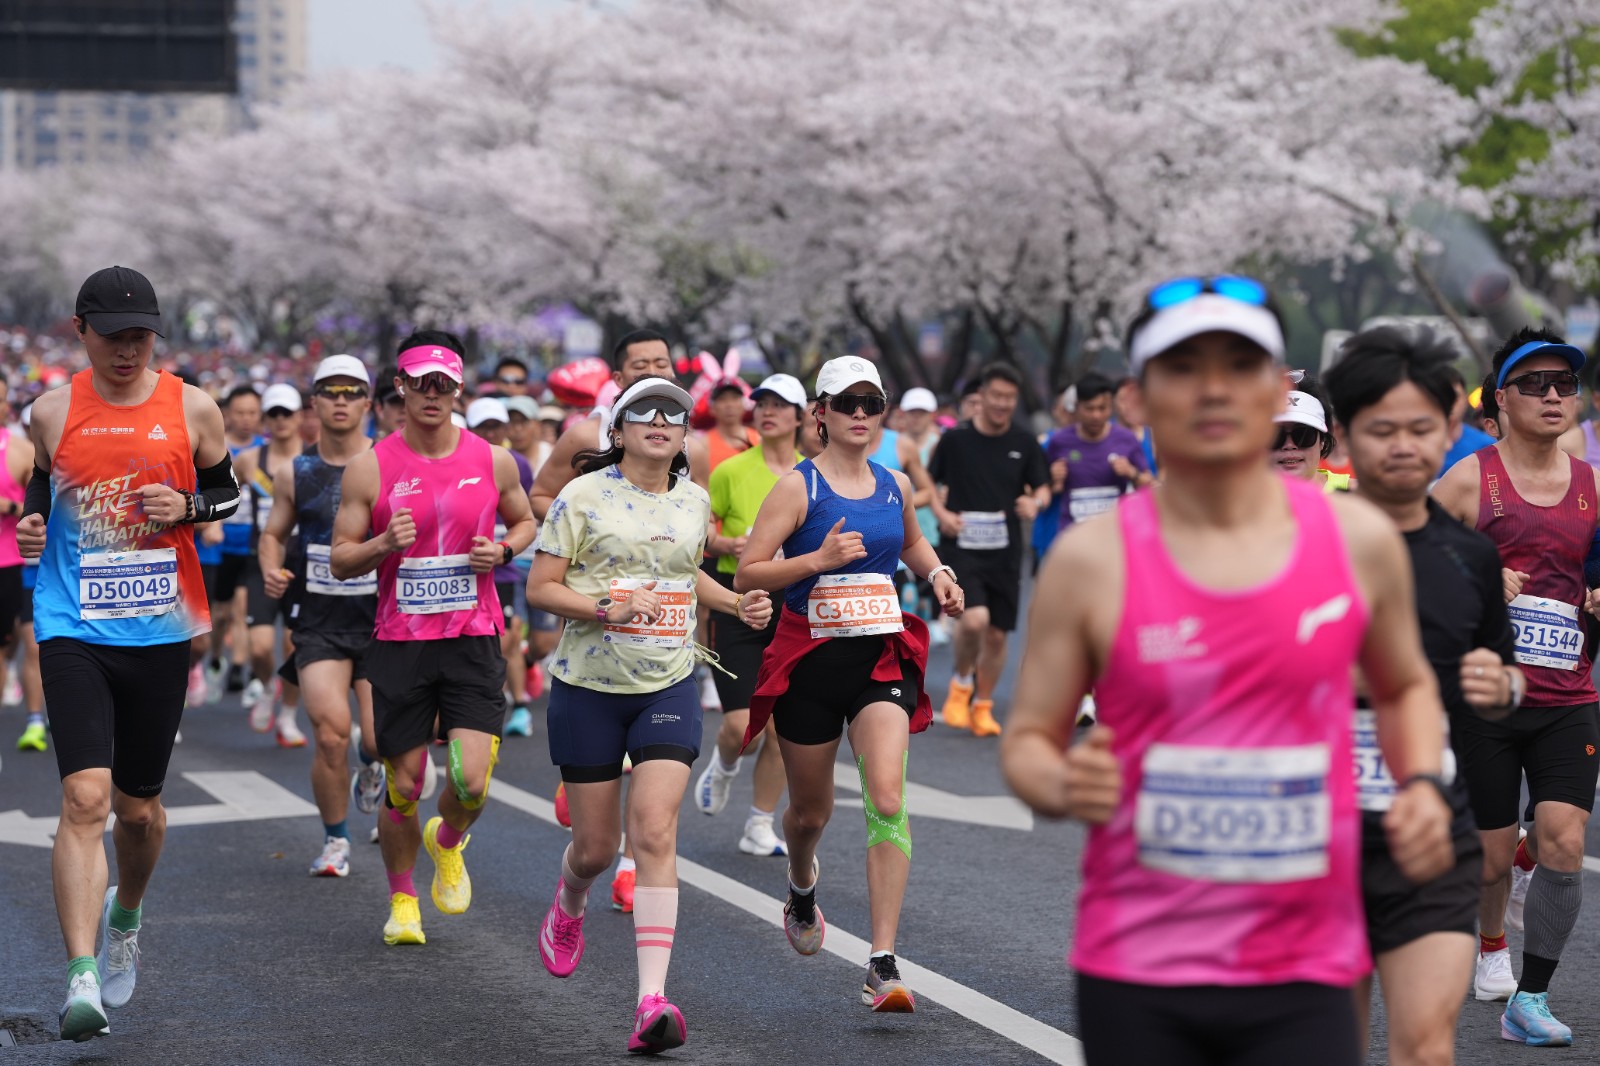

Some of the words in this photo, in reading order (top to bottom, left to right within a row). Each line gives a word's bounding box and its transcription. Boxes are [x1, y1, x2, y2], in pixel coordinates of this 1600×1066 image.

[76, 470, 140, 503] WEST
[1487, 473, 1504, 517] FLIPBELT
[72, 489, 140, 520] LAKE
[80, 511, 127, 537] HALF
[88, 577, 171, 600] D50049
[403, 578, 471, 598] D50083
[815, 598, 894, 620] C34362
[1154, 803, 1317, 843] D50933
